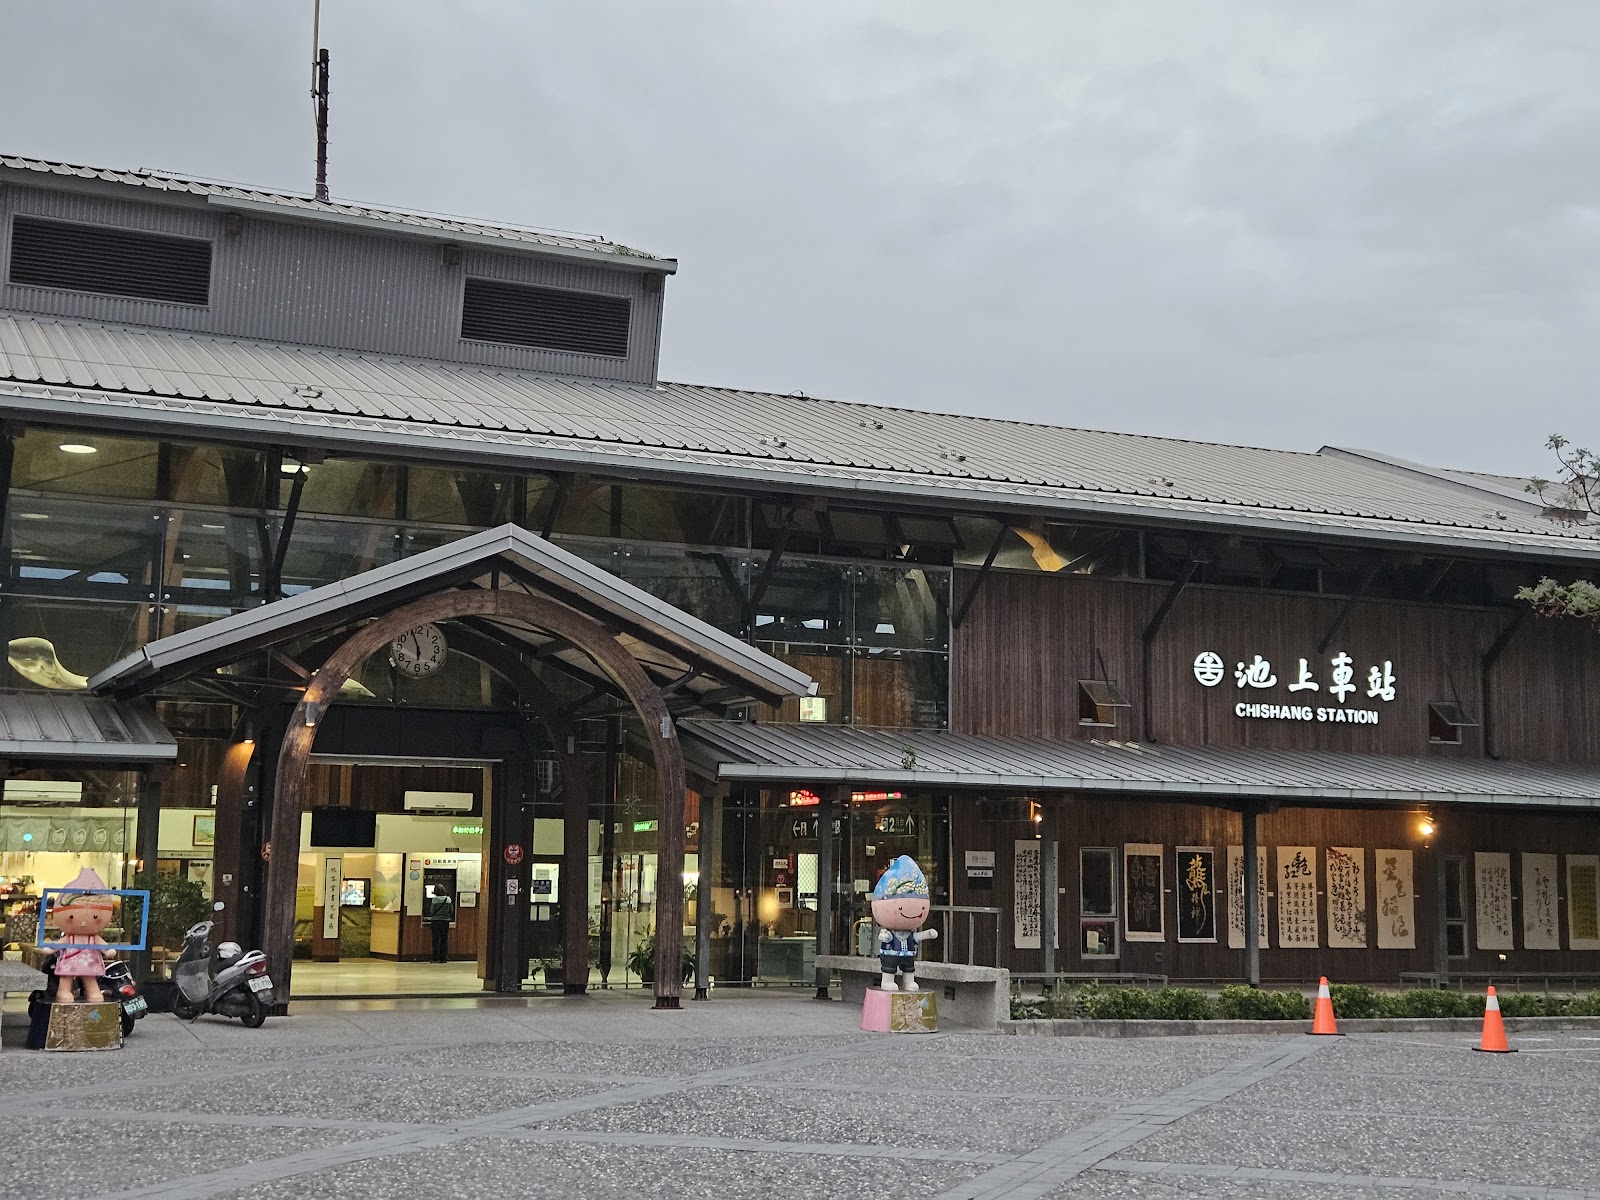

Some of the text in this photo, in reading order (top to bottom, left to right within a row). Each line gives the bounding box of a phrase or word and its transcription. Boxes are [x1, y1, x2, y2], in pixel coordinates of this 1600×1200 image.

[415, 626, 424, 634] 12
[426, 629, 429, 638] 1
[398, 634, 406, 643] 10
[432, 636, 438, 644] 2
[396, 644, 402, 652] 9
[434, 646, 440, 654] 3
[398, 652, 404, 662] 8
[430, 655, 436, 663] 4
[404, 660, 412, 669] 7
[414, 664, 420, 672] 6
[424, 662, 430, 670] 5
[1234, 651, 1397, 704] 池上車站
[1235, 702, 1379, 725] CHISHANG STATION
